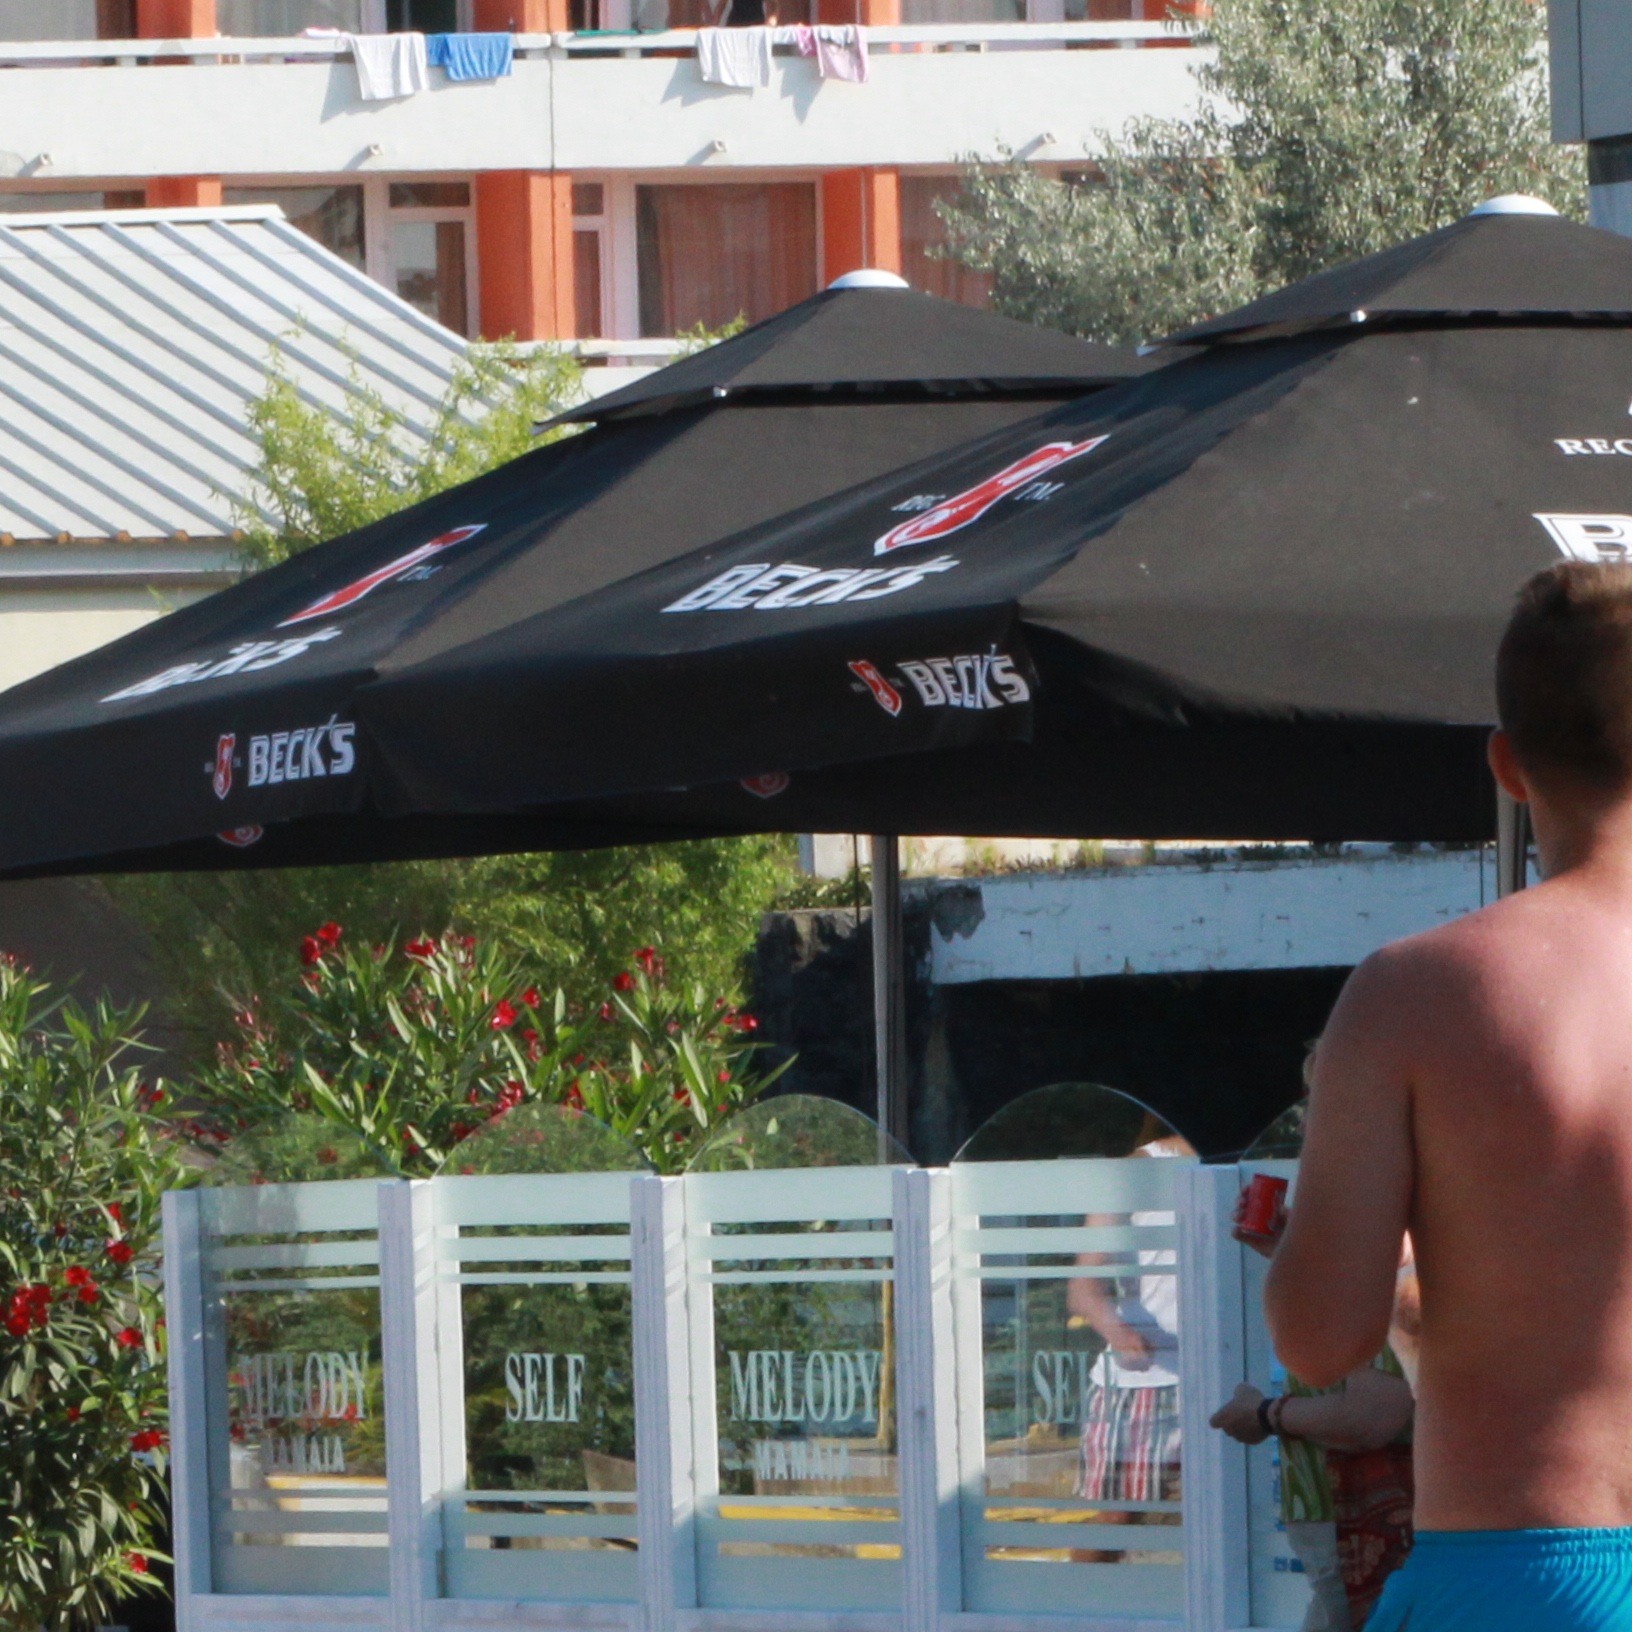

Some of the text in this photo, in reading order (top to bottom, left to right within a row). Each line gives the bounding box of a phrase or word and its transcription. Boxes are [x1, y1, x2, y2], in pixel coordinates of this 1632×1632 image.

[660, 555, 960, 613] BECK'S
[897, 644, 1030, 709] BECK'S
[248, 714, 355, 786] BECK'S
[238, 1352, 368, 1419] MELODY
[505, 1352, 585, 1422] SELF
[728, 1350, 882, 1424] MELODY
